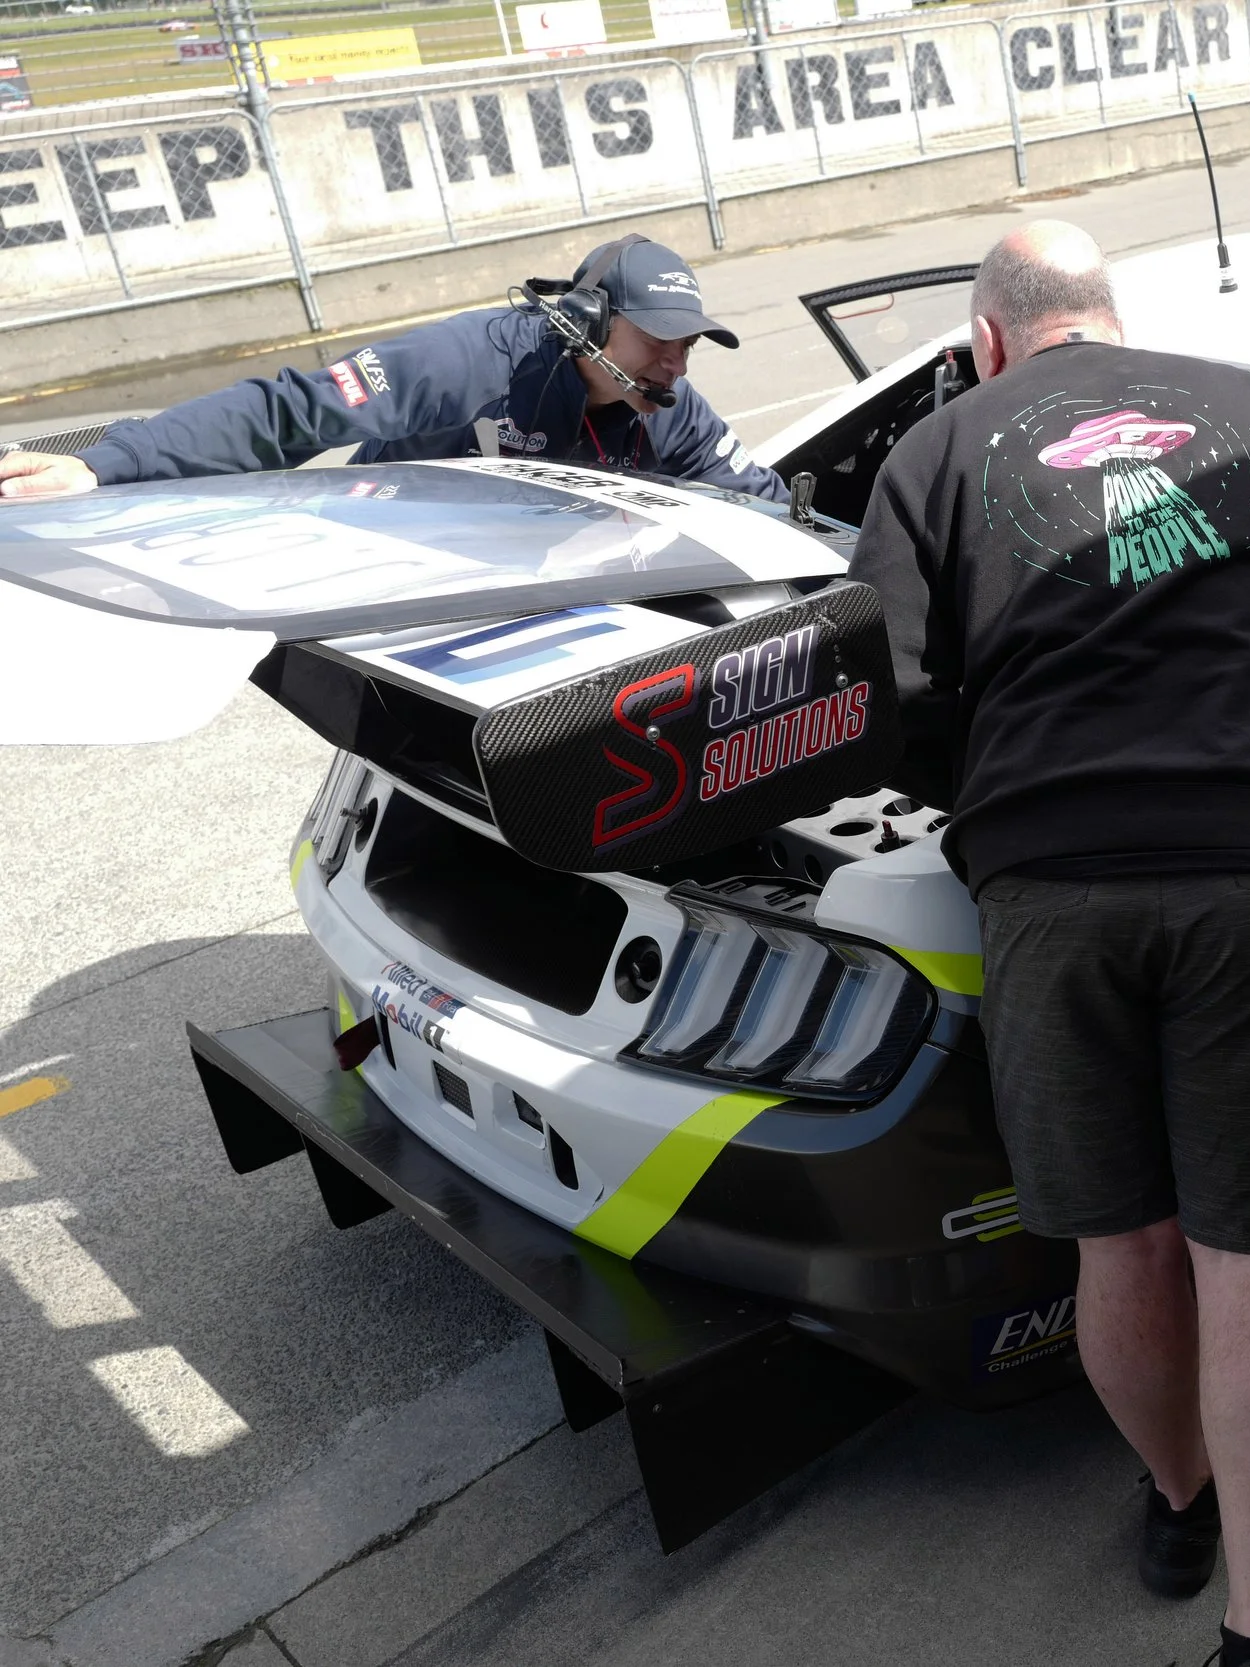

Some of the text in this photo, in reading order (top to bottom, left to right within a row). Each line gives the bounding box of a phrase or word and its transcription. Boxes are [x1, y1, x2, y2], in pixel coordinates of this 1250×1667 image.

[343, 77, 654, 192] THIS
[732, 41, 954, 140] AREA
[1009, 5, 1231, 92] CLEAR
[613, 491, 680, 507] OMP
[1103, 464, 1196, 530] POWER
[1126, 505, 1177, 535] TO THE
[1109, 510, 1231, 590] PEOPLE
[708, 625, 816, 729] SIGN
[701, 681, 870, 802] SOLUTIONS
[372, 984, 423, 1041] Mobil
[987, 1340, 1068, 1373] Challenge
